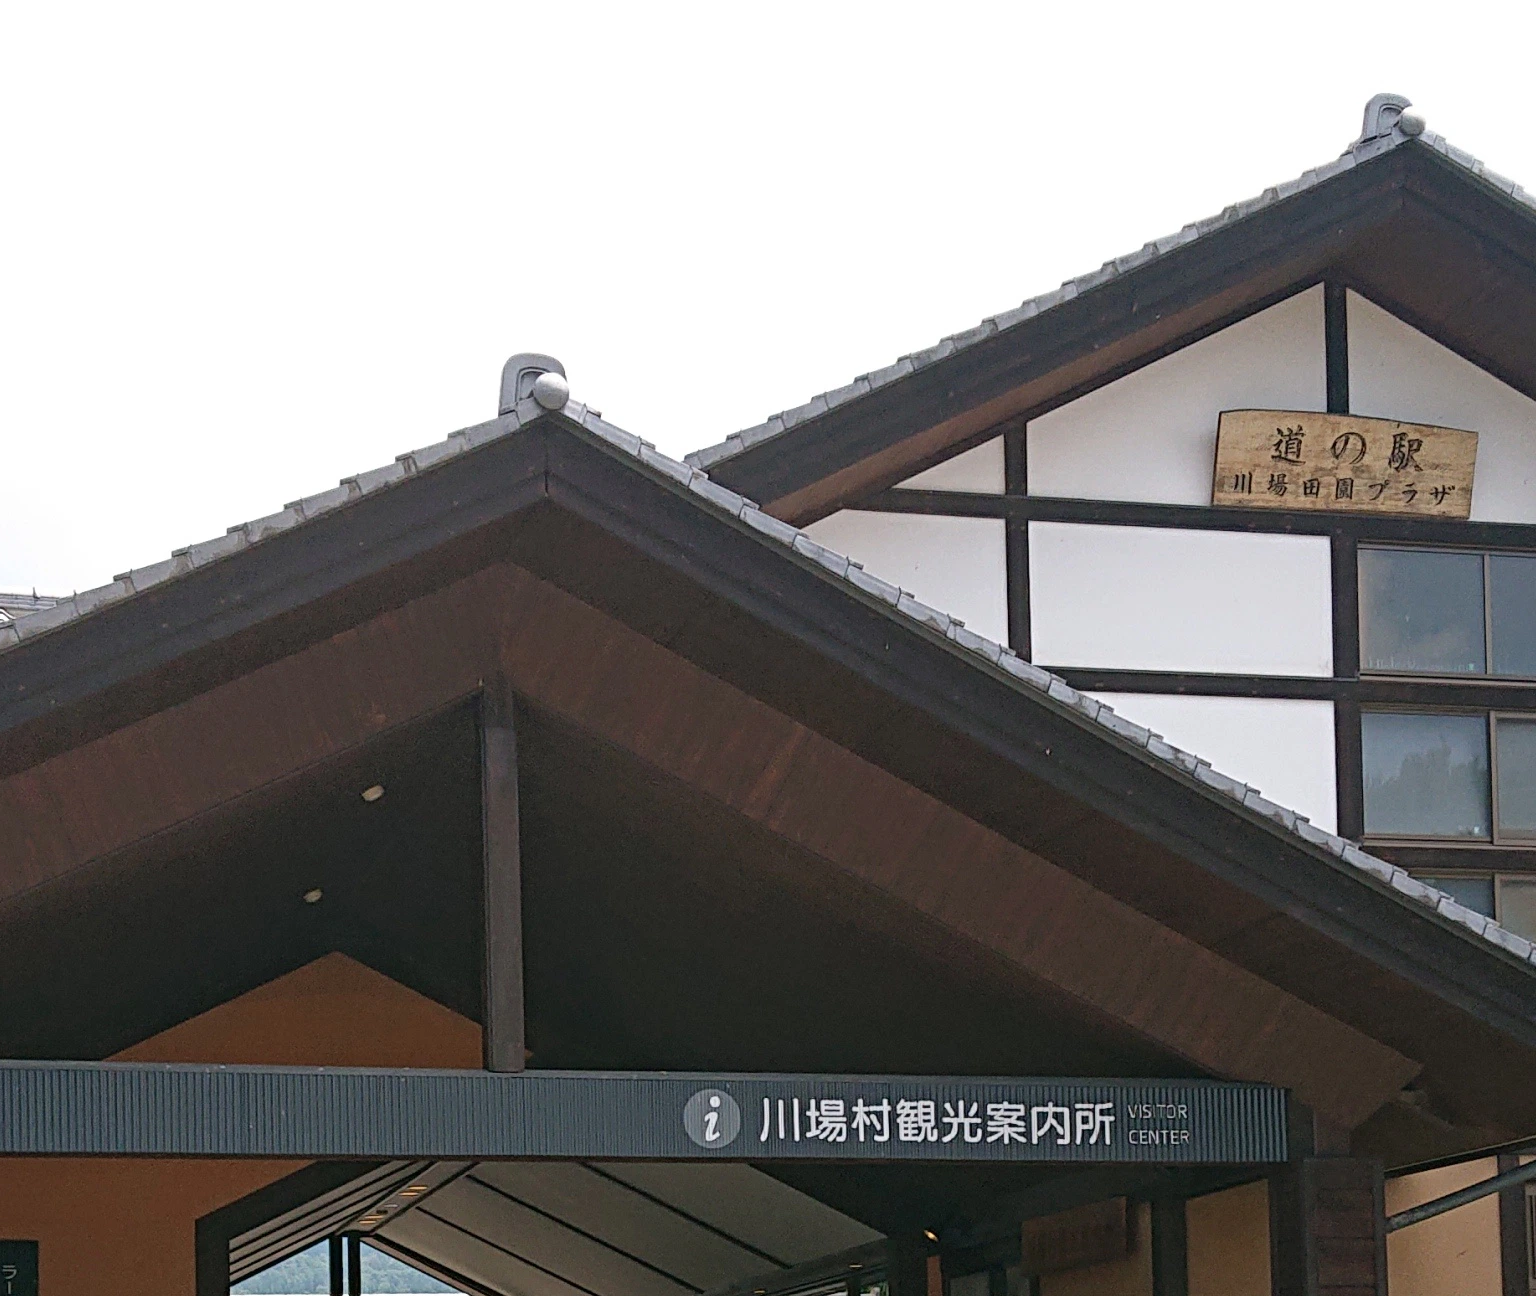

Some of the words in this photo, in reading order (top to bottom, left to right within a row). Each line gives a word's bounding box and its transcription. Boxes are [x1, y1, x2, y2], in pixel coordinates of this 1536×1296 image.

[1270, 423, 1424, 473] 道の駅
[1232, 471, 1456, 506] 川場田園プラザ
[759, 1097, 1117, 1147] 川場村観光案内所
[1127, 1103, 1189, 1121] VISITOR
[1128, 1129, 1190, 1146] CENTER
